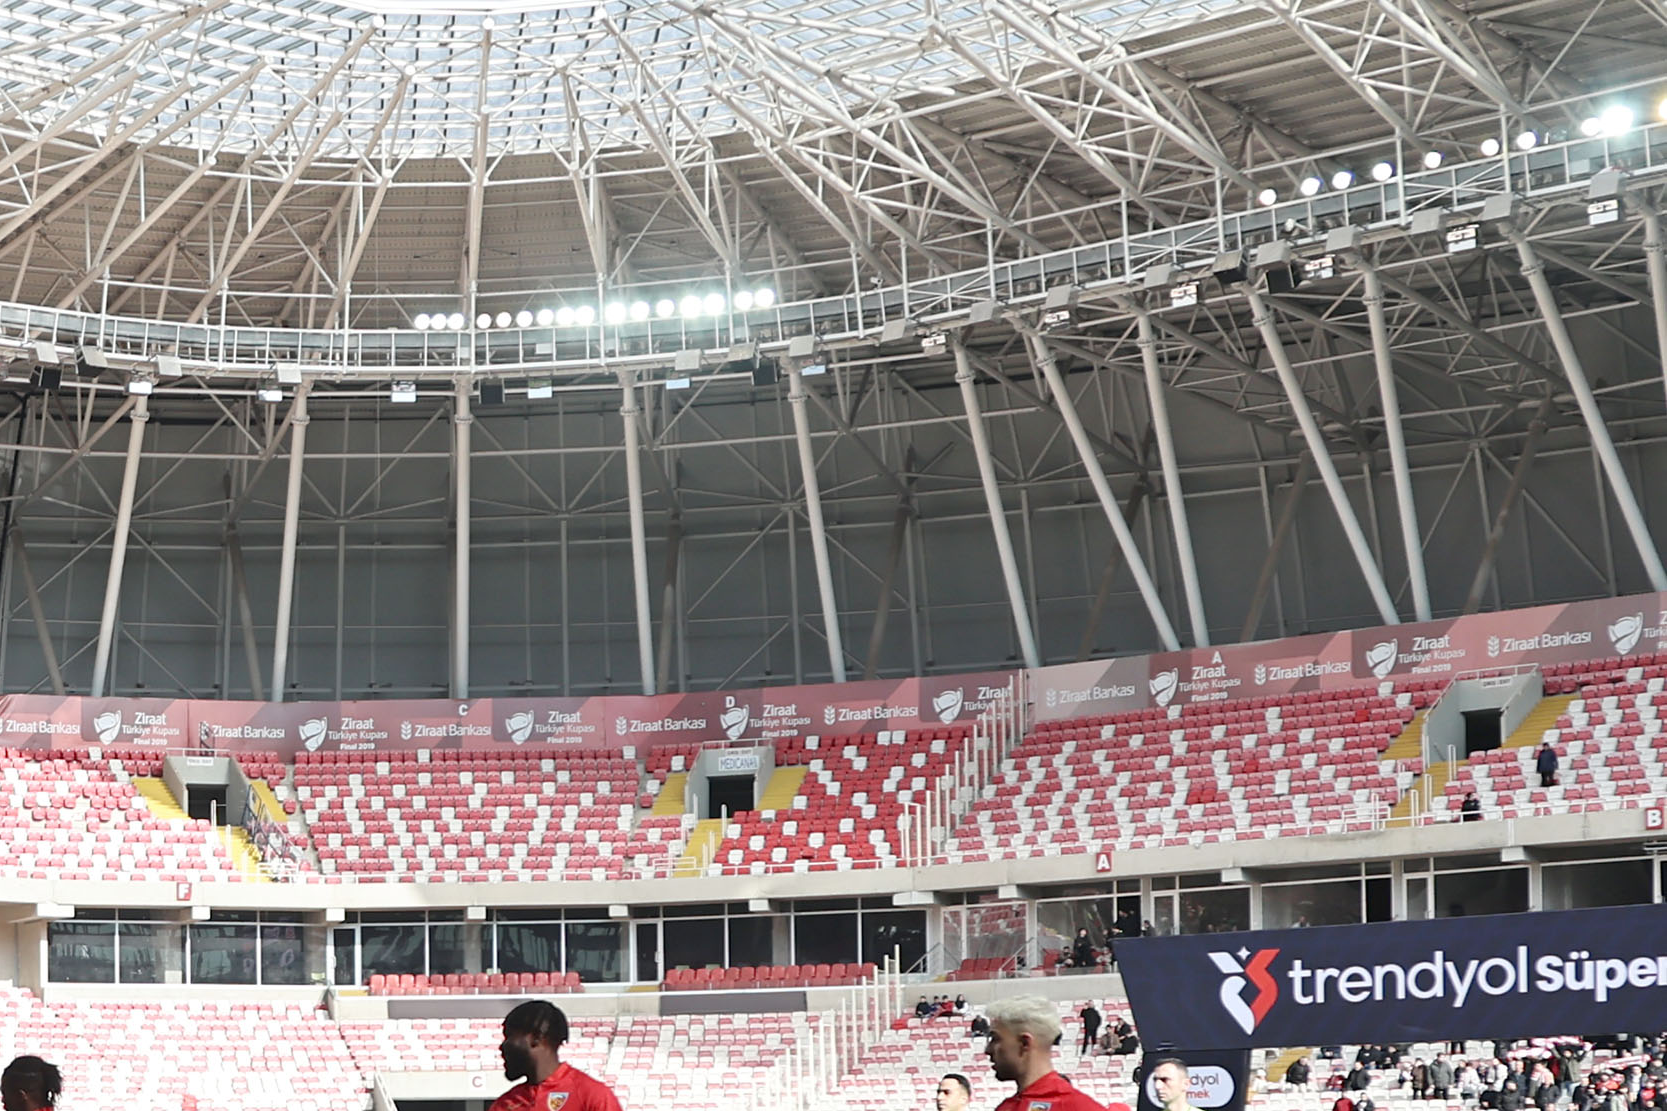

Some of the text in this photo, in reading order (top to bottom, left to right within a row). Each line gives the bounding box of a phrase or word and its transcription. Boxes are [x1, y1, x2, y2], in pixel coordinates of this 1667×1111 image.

[1412, 634, 1450, 651] Ziraat
[1502, 632, 1592, 653] Ziraat Bankası
[1212, 652, 1222, 663] A
[1192, 664, 1227, 680] Ziraat
[1269, 661, 1351, 681] Ziraat Bankası
[725, 696, 735, 709] D
[763, 703, 797, 716] Ziraat
[458, 704, 468, 717] C
[548, 710, 581, 724] Ziraat
[838, 705, 918, 721] Ziraat Bankası
[135, 712, 166, 726] Ziraat
[341, 717, 374, 731] Ziraat
[630, 717, 706, 732] Ziraat Bankası
[6, 719, 80, 735] Ziraat Bankası
[212, 724, 285, 739] Ziraat Bankası
[414, 723, 491, 737] Ziraat Bankası
[1647, 810, 1662, 826] B
[1097, 853, 1111, 871] A
[179, 884, 190, 899] F
[472, 1076, 483, 1088] C
[1190, 1073, 1219, 1087] dyol
[1186, 1090, 1210, 1099] mek
